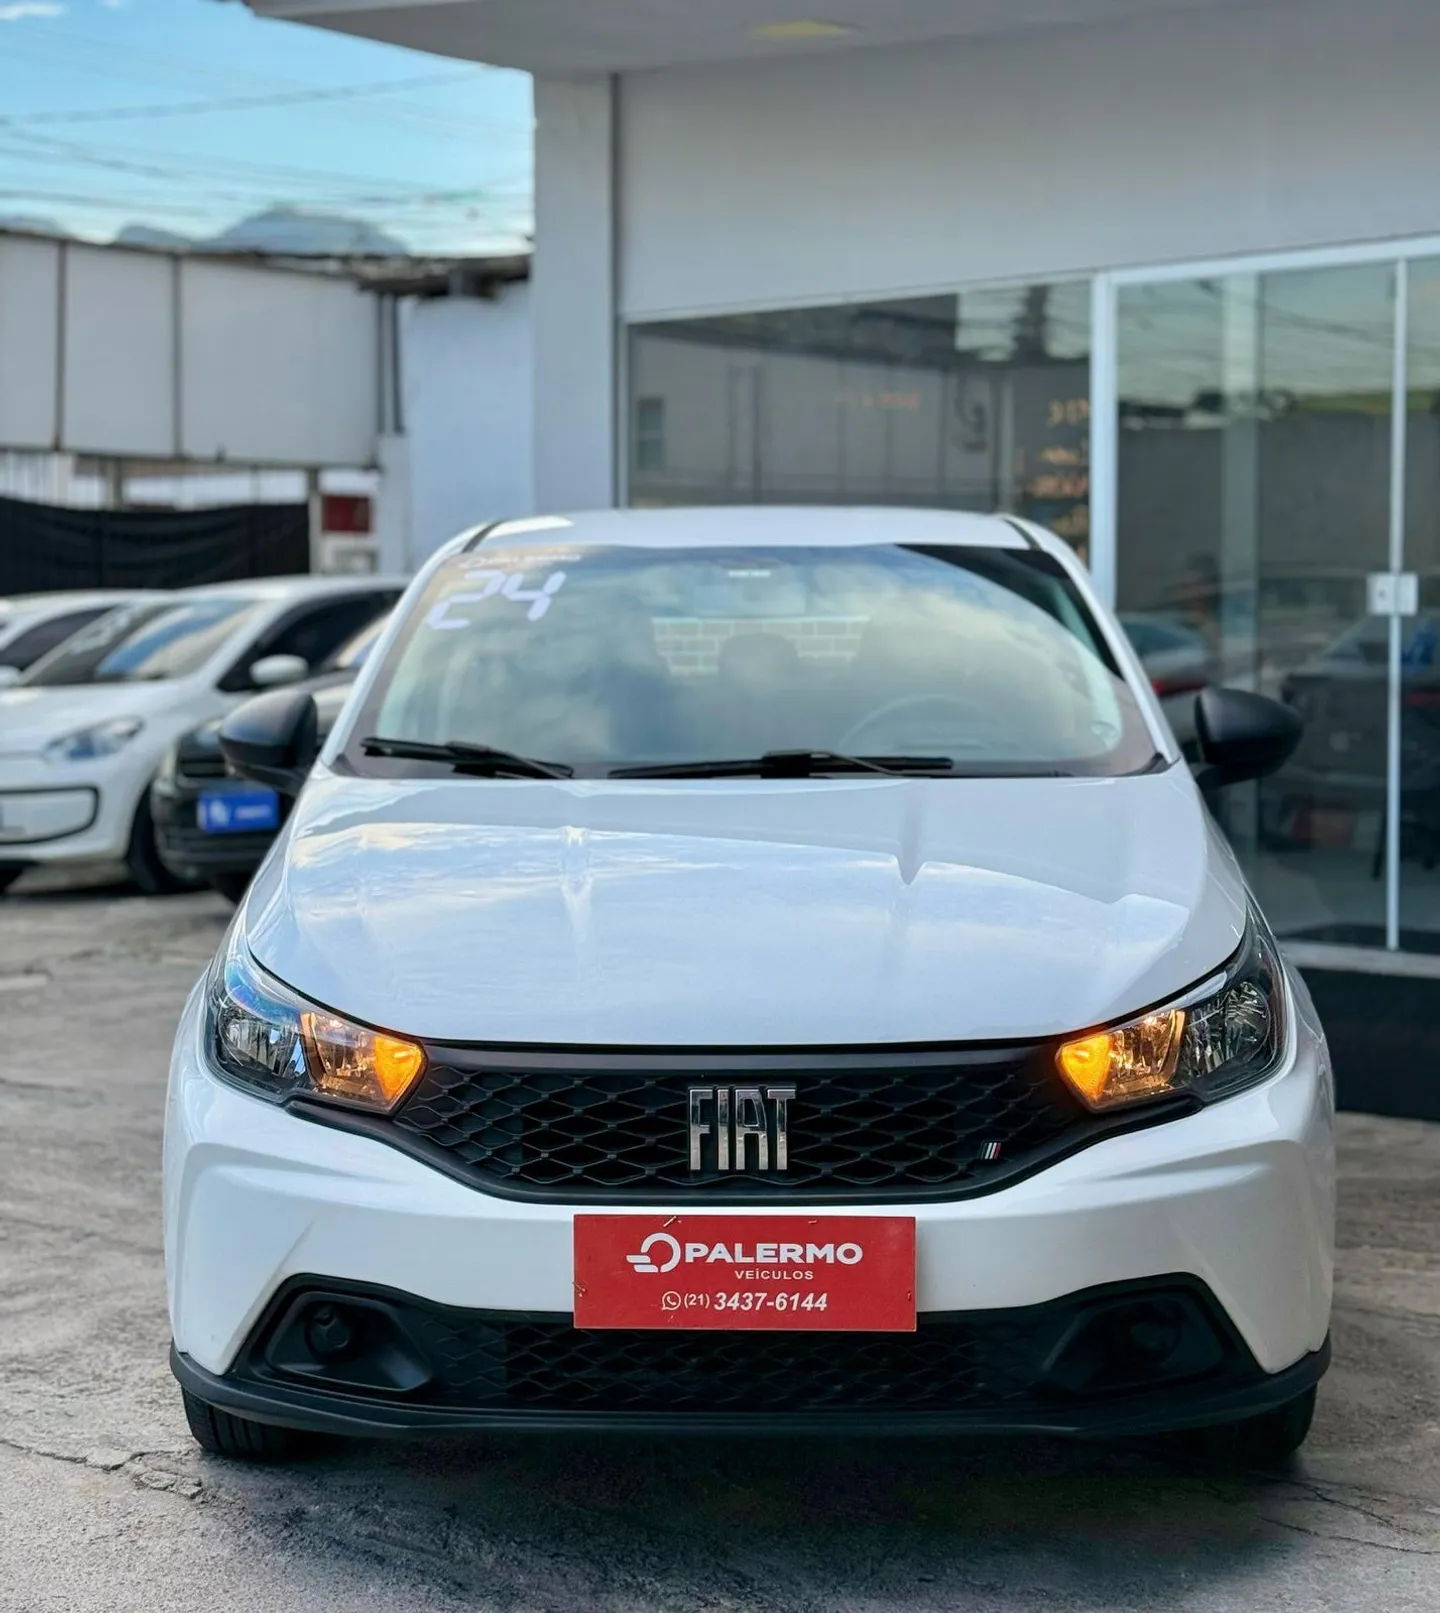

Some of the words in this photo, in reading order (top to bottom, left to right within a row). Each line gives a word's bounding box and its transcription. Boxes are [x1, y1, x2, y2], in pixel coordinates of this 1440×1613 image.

[426, 569, 567, 630] 24
[689, 1086, 797, 1171] FIAT
[685, 1242, 863, 1265] PALERMO
[735, 1269, 814, 1280] VEÍCULOS
[684, 1293, 710, 1309] (21)
[714, 1292, 827, 1312] 3437-6144
